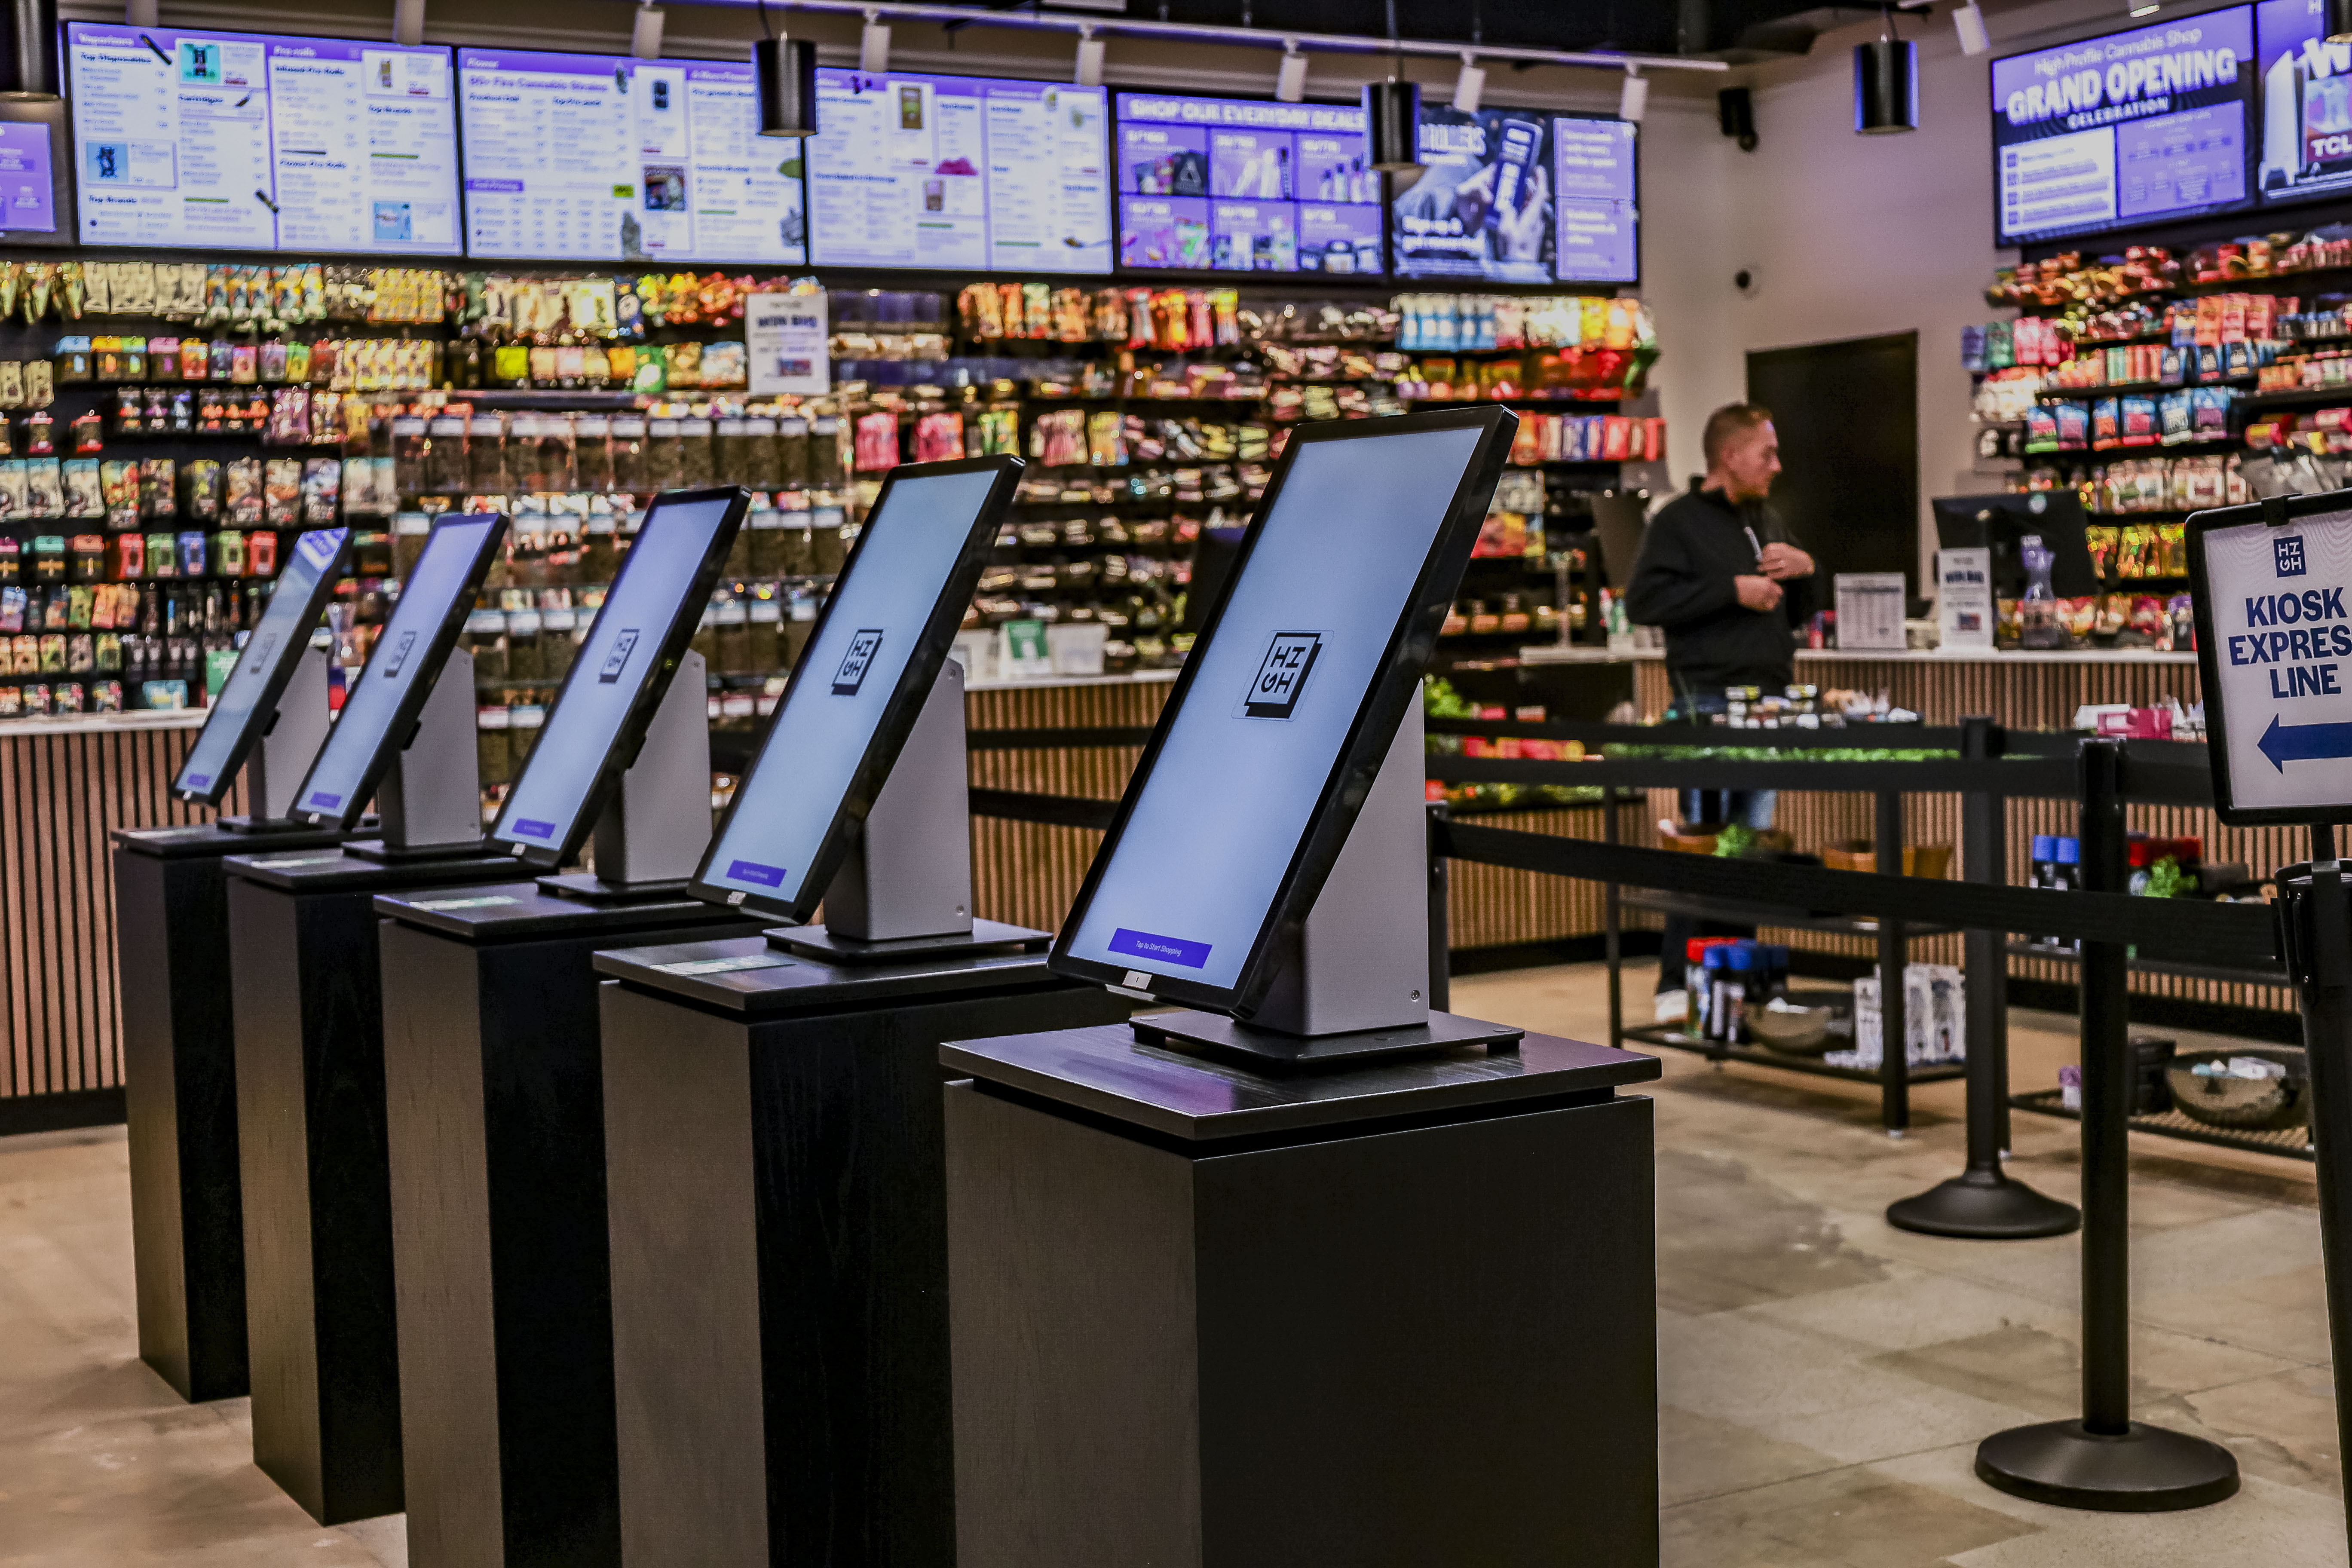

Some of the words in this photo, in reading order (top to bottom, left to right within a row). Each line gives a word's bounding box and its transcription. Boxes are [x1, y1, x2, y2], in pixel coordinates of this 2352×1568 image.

[2035, 56, 2063, 76] High
[2065, 48, 2104, 67] Profile
[2105, 34, 2164, 60] Cannabis
[2165, 28, 2202, 47] Shop
[2007, 69, 2102, 126] GRAND
[2106, 48, 2237, 104] OPENING
[1130, 100, 1179, 117] SHOP
[1182, 103, 1221, 120] OUR
[2067, 97, 2169, 128] CELEBRATION
[2310, 134, 2352, 158] TCL
[2245, 586, 2349, 628] KIOSK
[2228, 624, 2352, 666] EXPRES
[2269, 663, 2342, 699] LINE
[1161, 945, 1182, 957] Shopping
